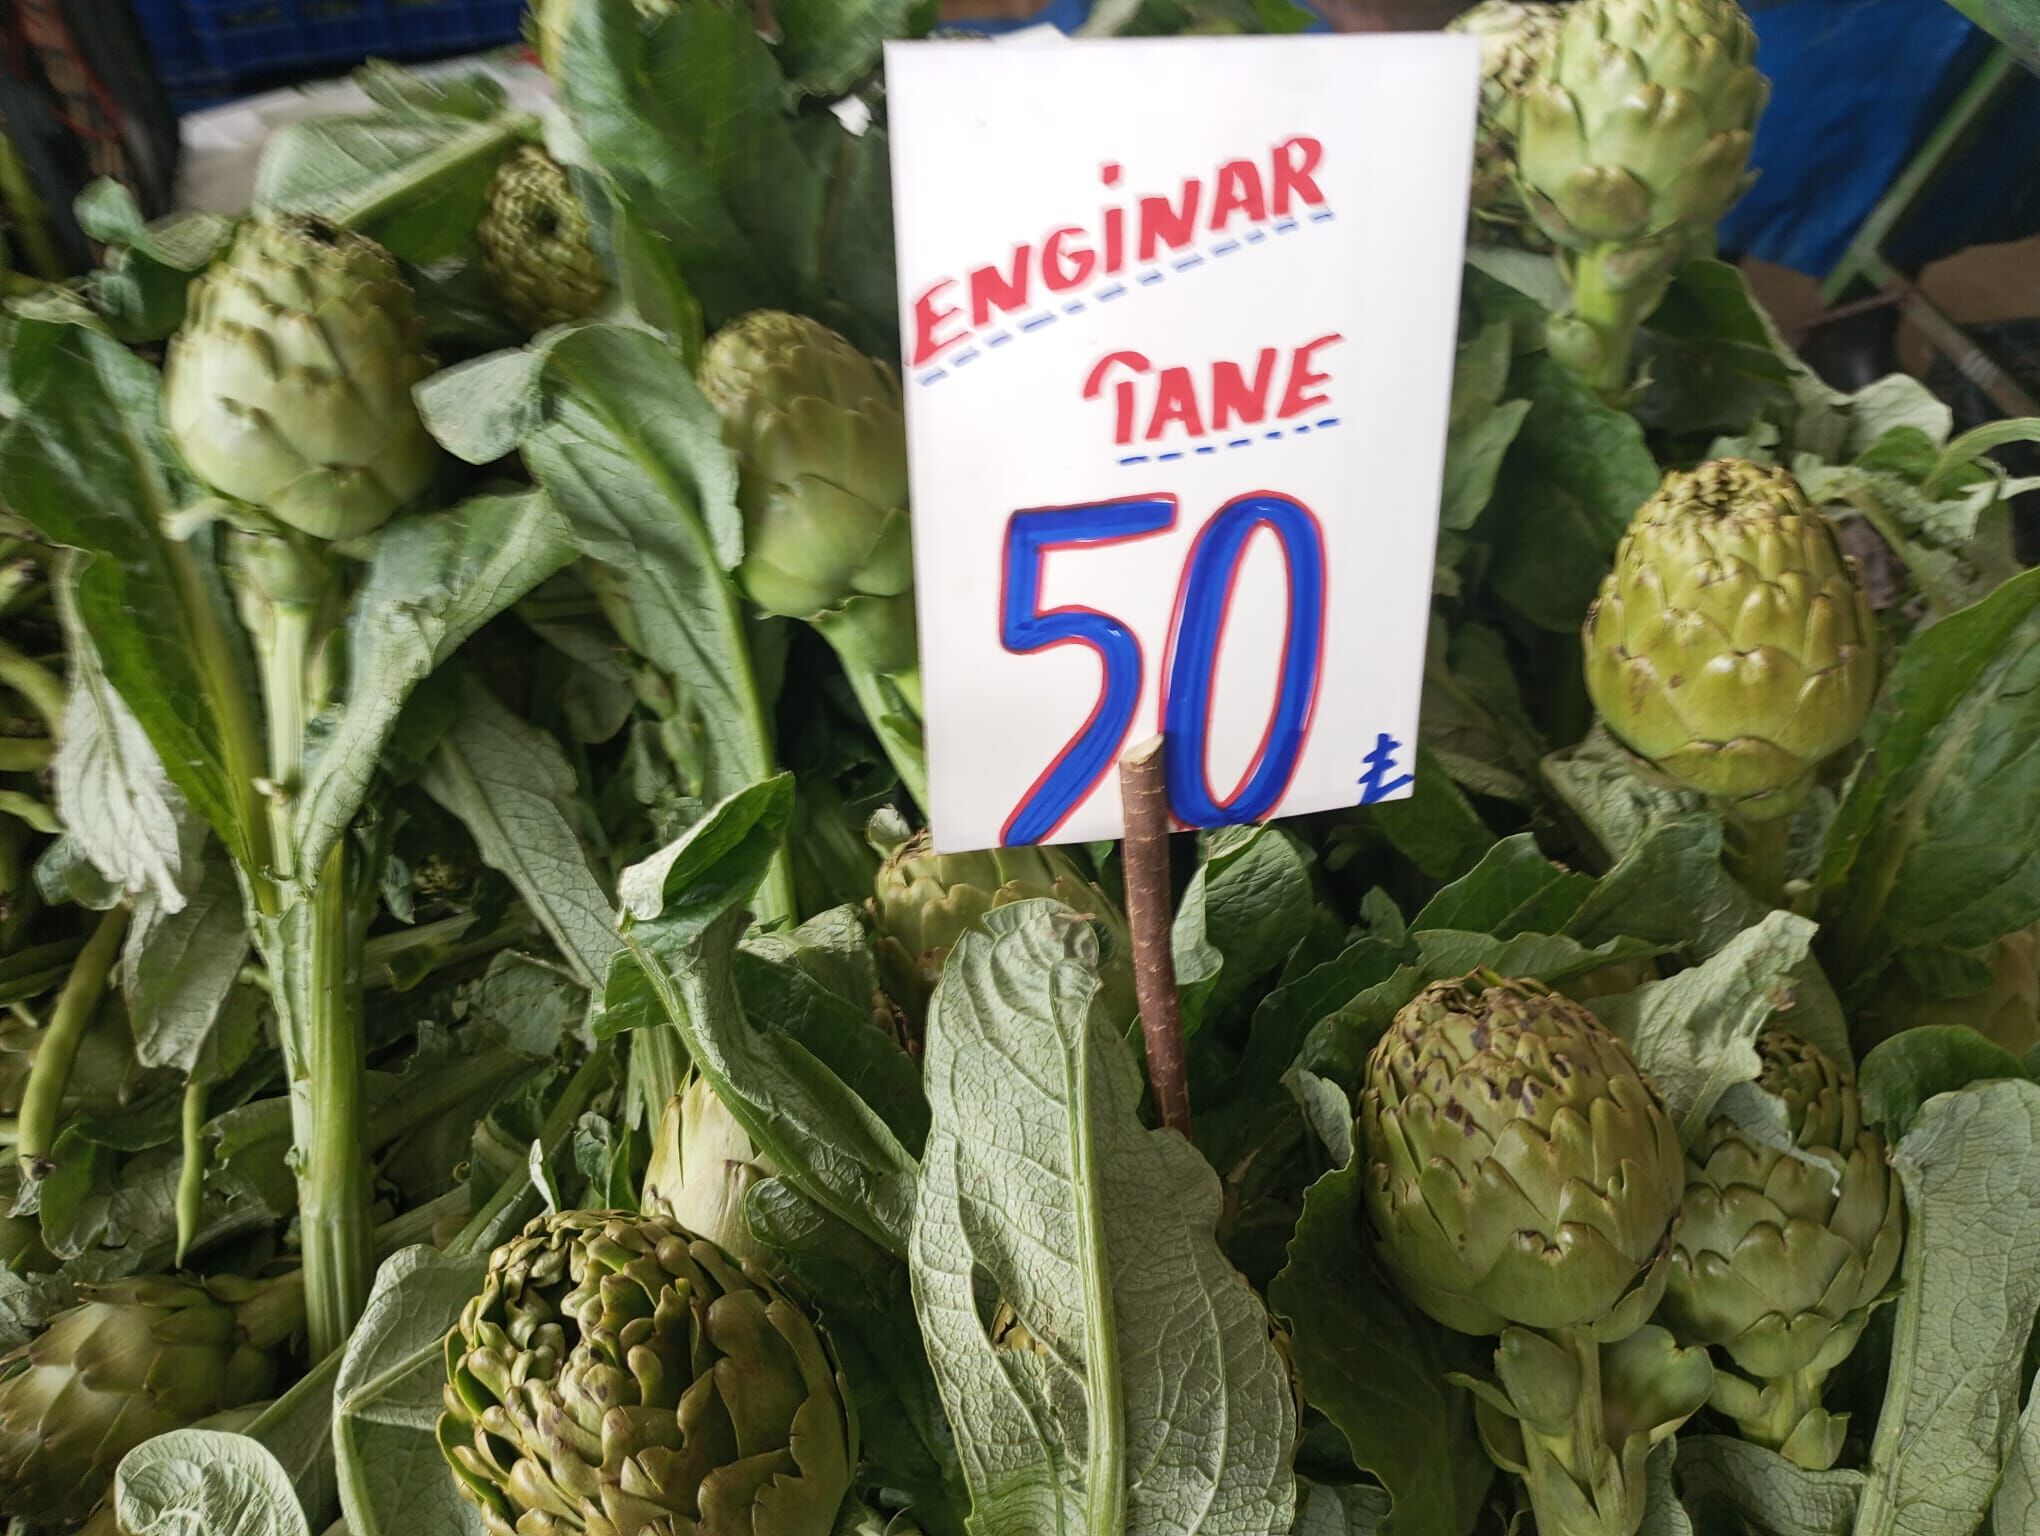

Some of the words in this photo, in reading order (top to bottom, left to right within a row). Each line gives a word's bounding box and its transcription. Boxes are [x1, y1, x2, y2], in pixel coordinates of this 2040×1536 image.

[908, 136, 1327, 368] ENGİNAR
[1082, 333, 1342, 446] TANE
[1000, 489, 1329, 848] 50
